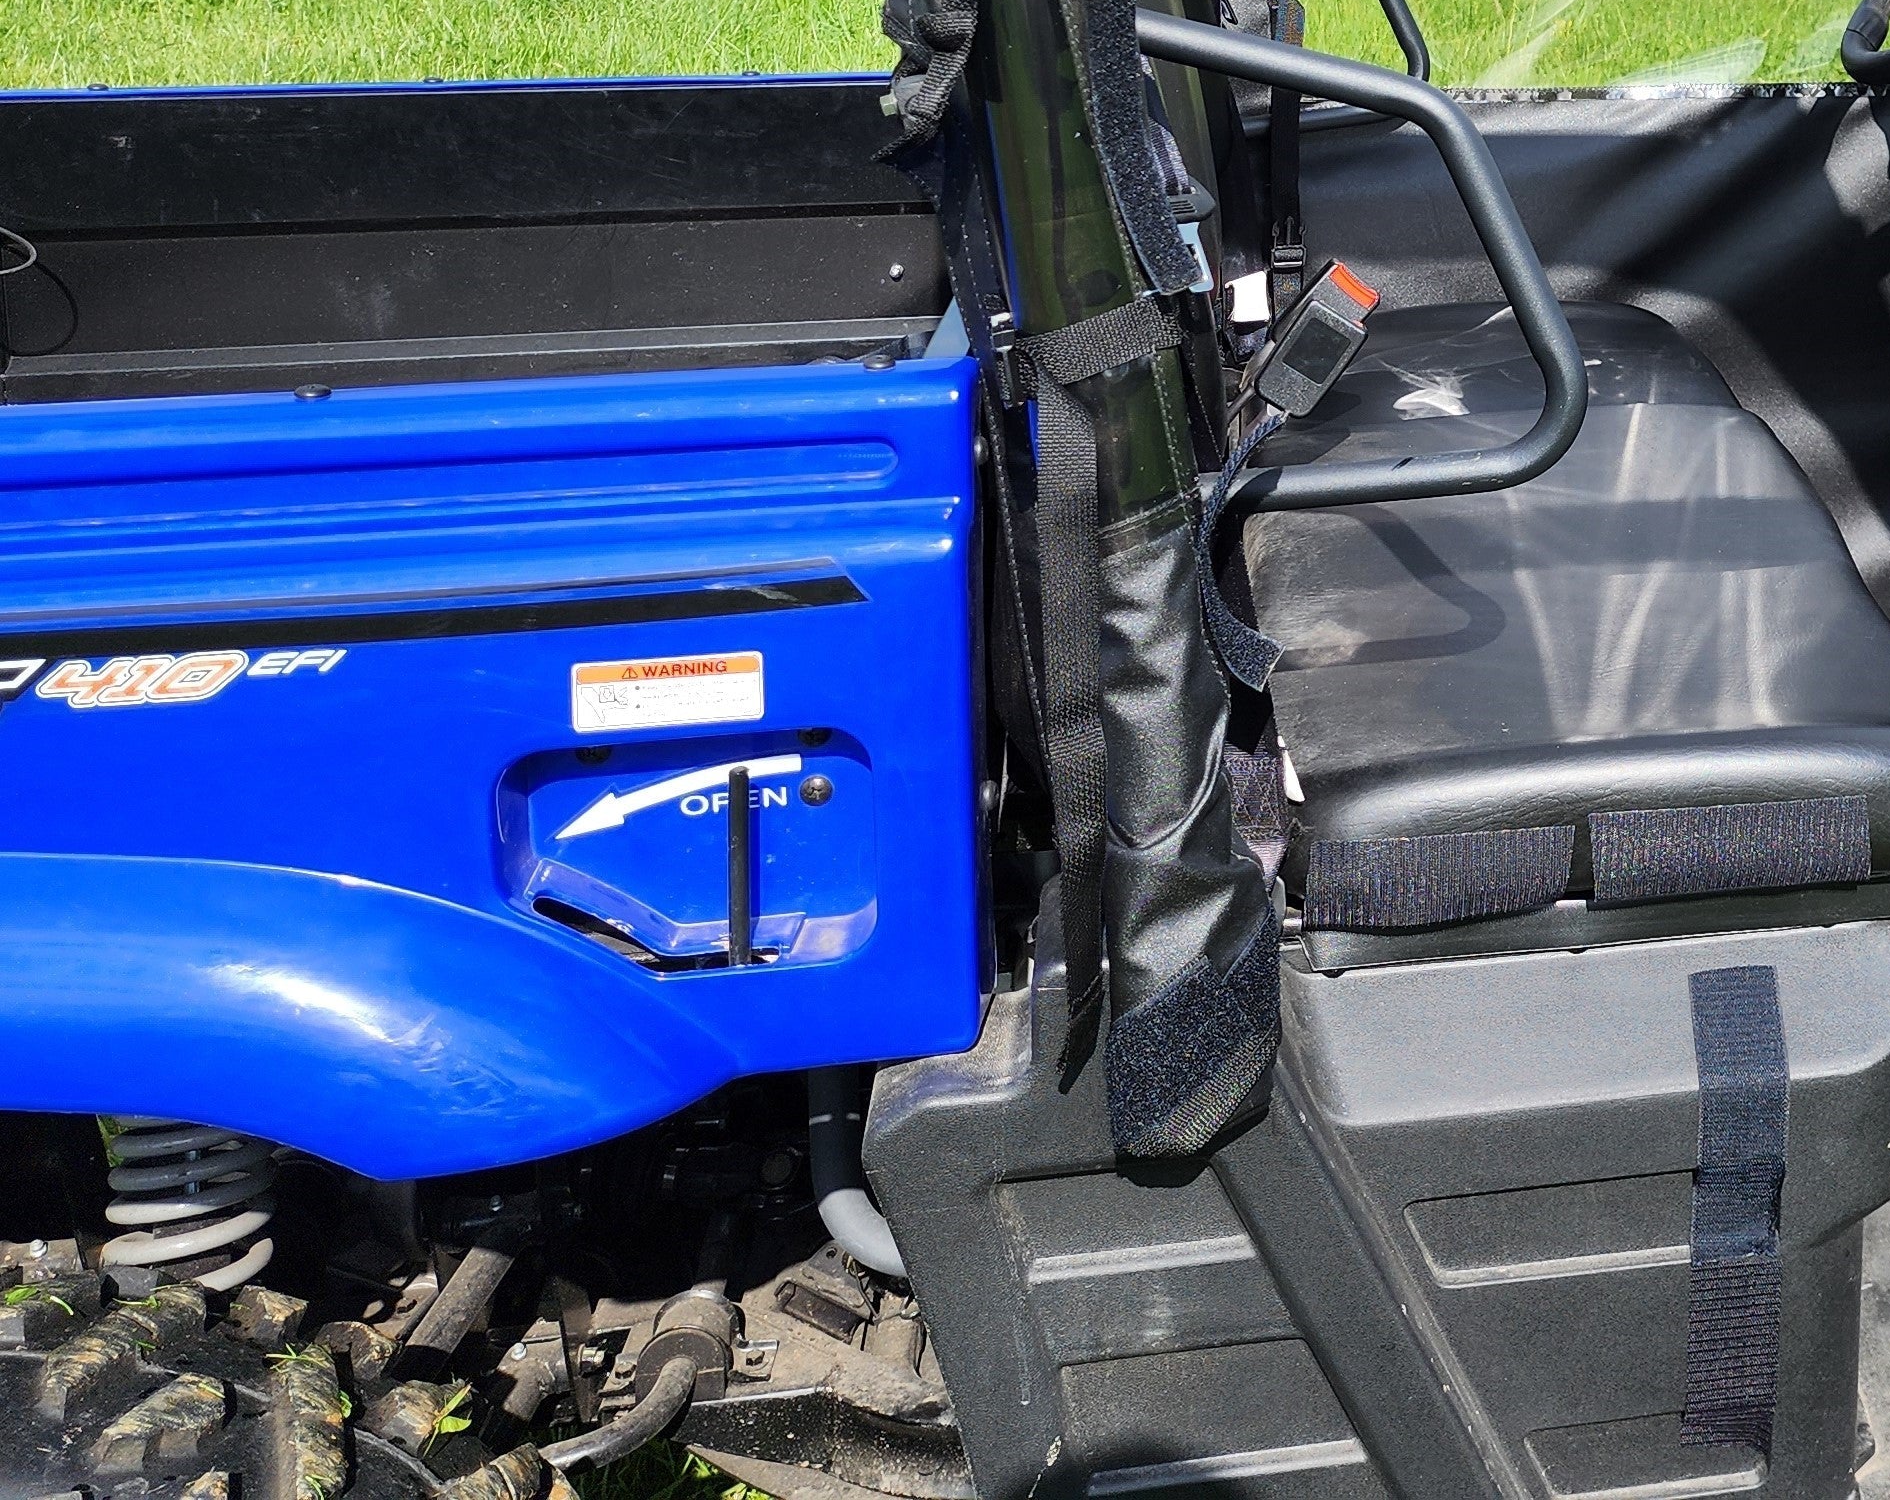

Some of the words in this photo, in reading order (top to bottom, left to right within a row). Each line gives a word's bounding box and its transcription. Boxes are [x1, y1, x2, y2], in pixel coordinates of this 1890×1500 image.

[38, 651, 246, 707] 410
[247, 650, 347, 675] EFI
[642, 660, 728, 678] WARNING
